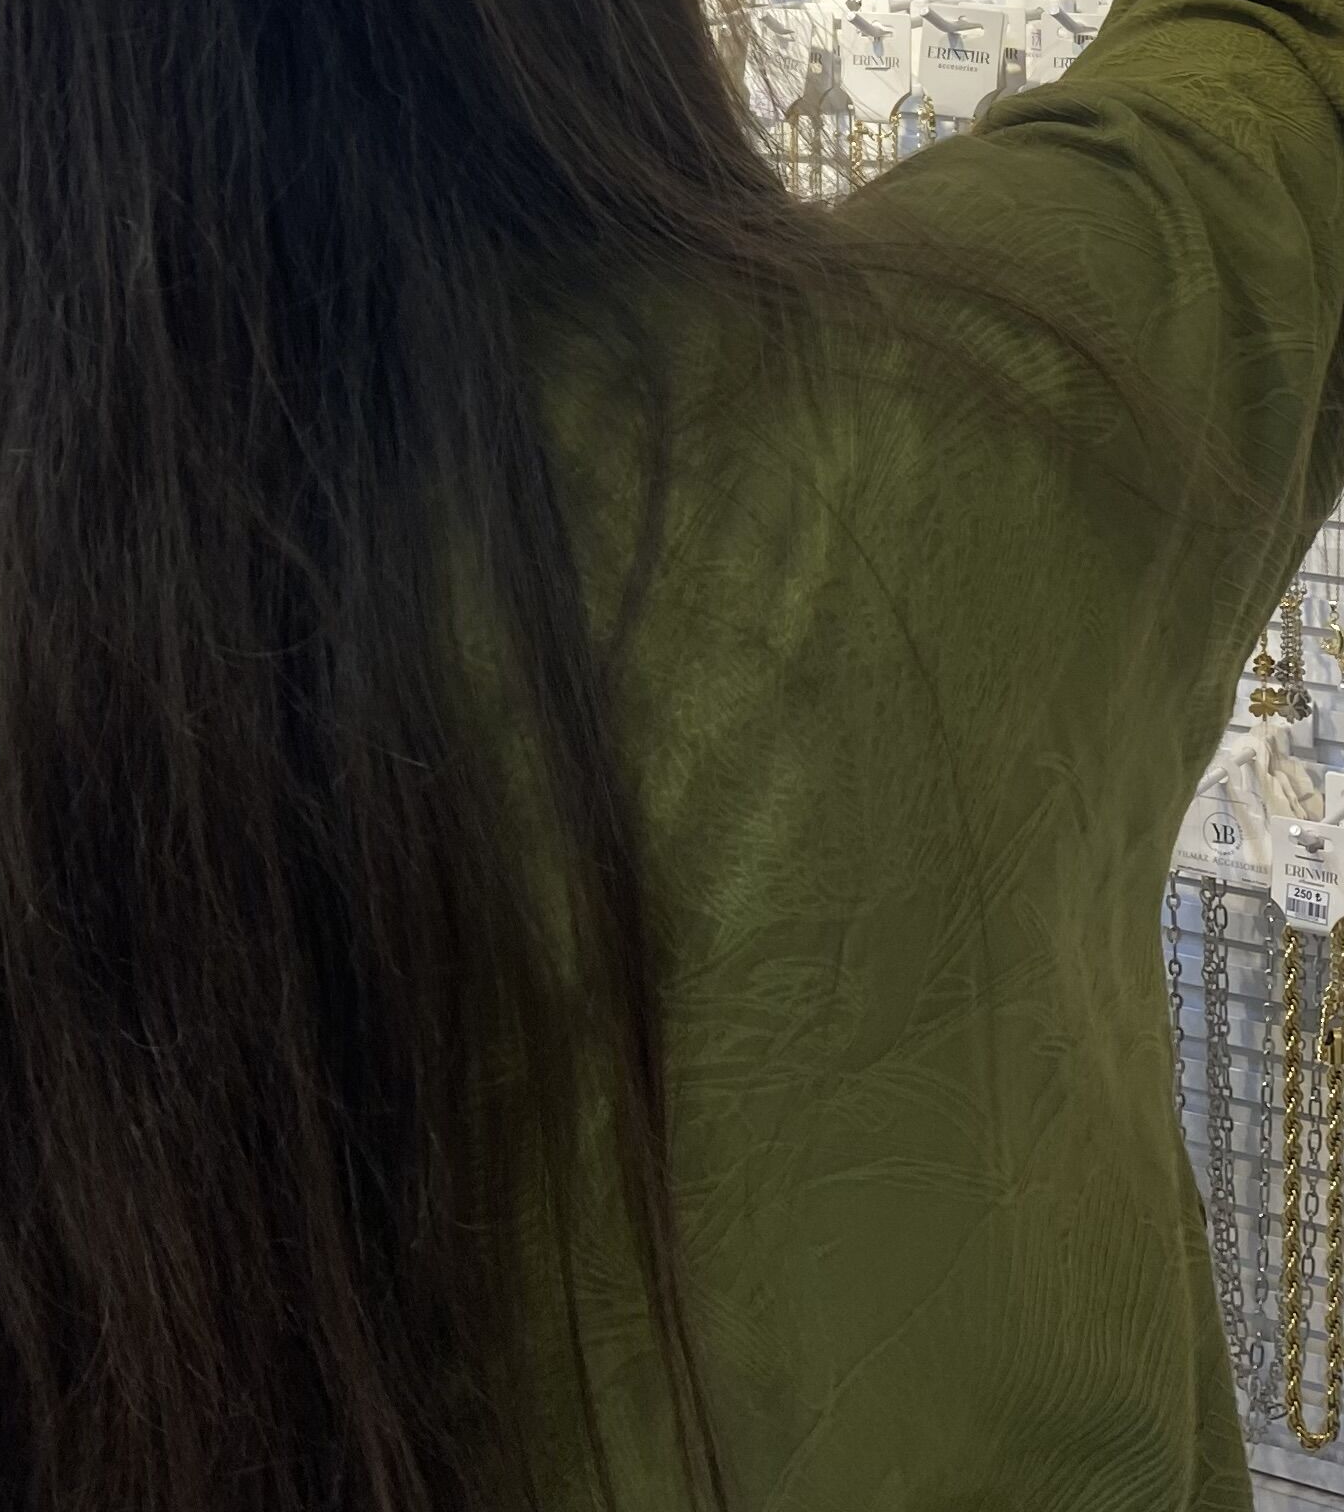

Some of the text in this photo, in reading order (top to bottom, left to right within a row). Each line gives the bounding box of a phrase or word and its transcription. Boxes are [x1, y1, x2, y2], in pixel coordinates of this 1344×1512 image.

[927, 45, 991, 65] ERINMIR
[1212, 823, 1235, 844] YB
[1285, 863, 1339, 886] ERINMIR
[1294, 888, 1313, 901] 250
